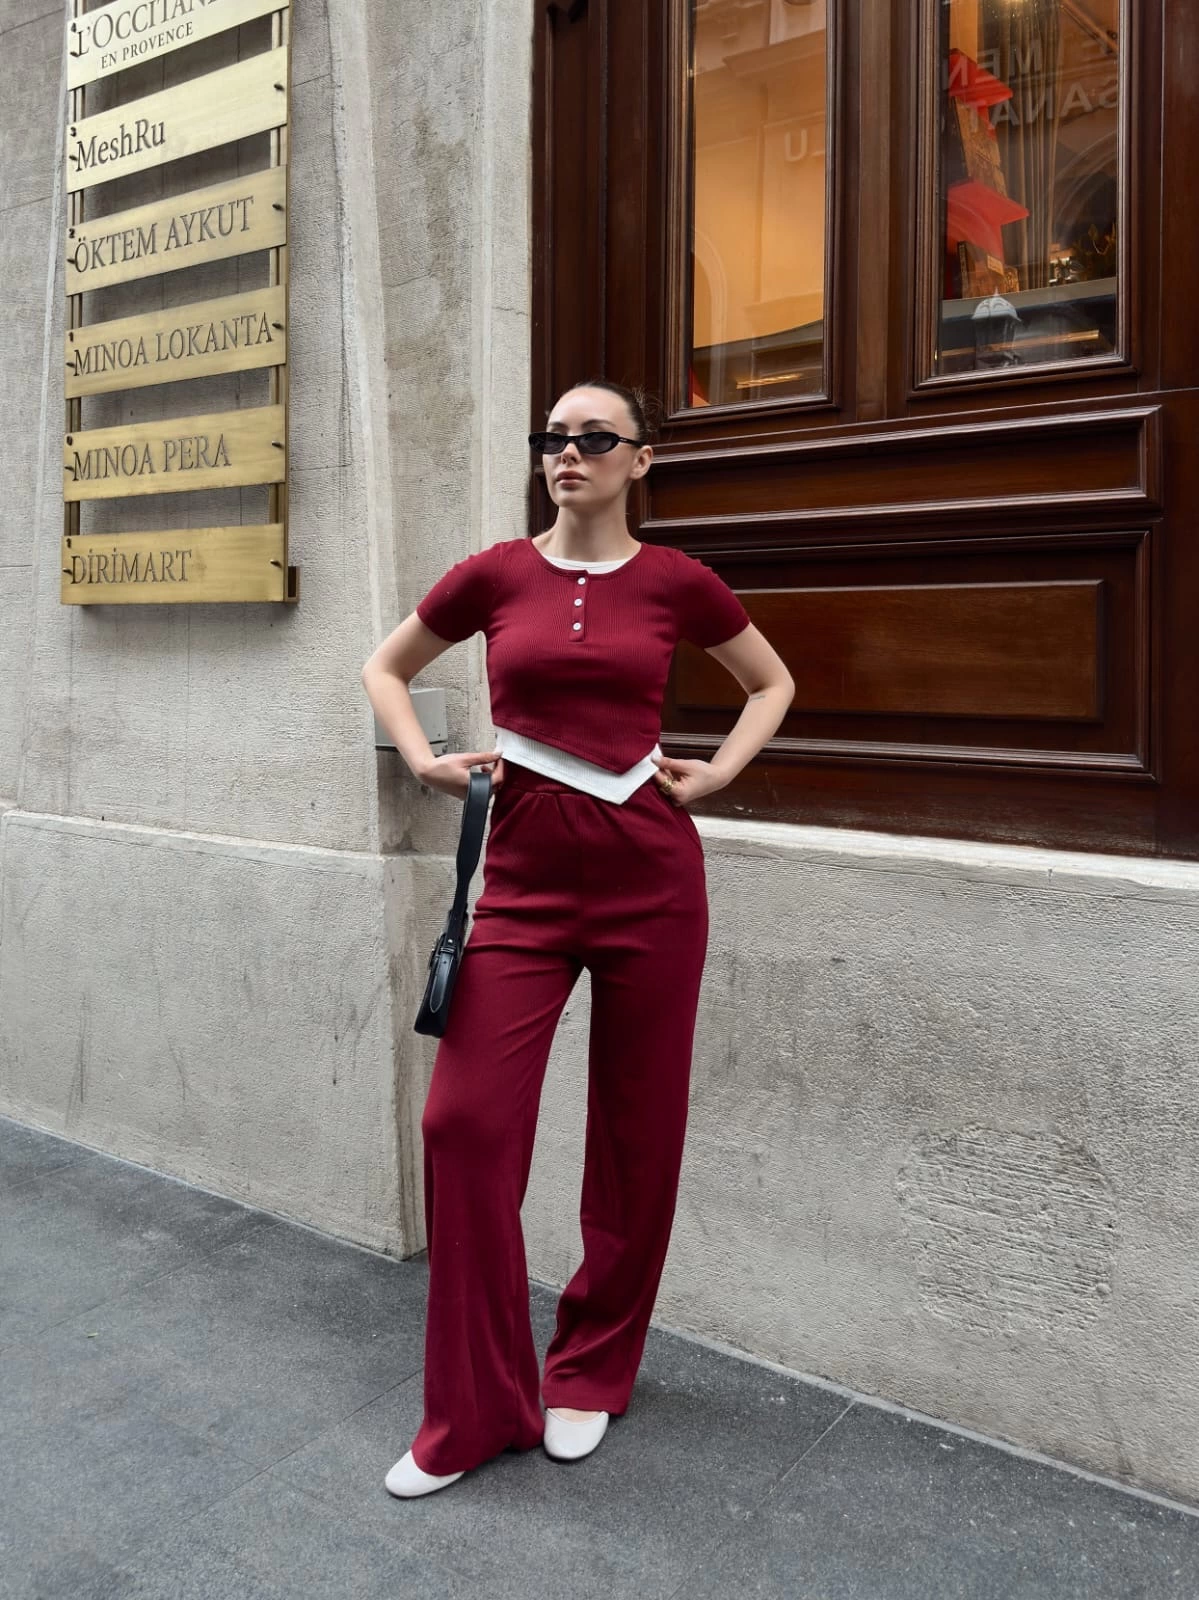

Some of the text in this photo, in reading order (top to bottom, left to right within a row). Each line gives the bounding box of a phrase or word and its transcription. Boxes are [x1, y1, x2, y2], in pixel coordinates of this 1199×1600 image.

[76, 0, 222, 57] L’OCCITA
[101, 21, 194, 69] EN PROVENCE
[70, 126, 77, 137] 3
[75, 119, 165, 172] MeshRu
[68, 228, 76, 239] 2
[74, 196, 254, 273] ÖKTEM AYKUT
[73, 311, 273, 377] MINOA LOKANTA
[72, 433, 232, 482] MINOA PERA
[70, 548, 192, 585] DİRİMART
